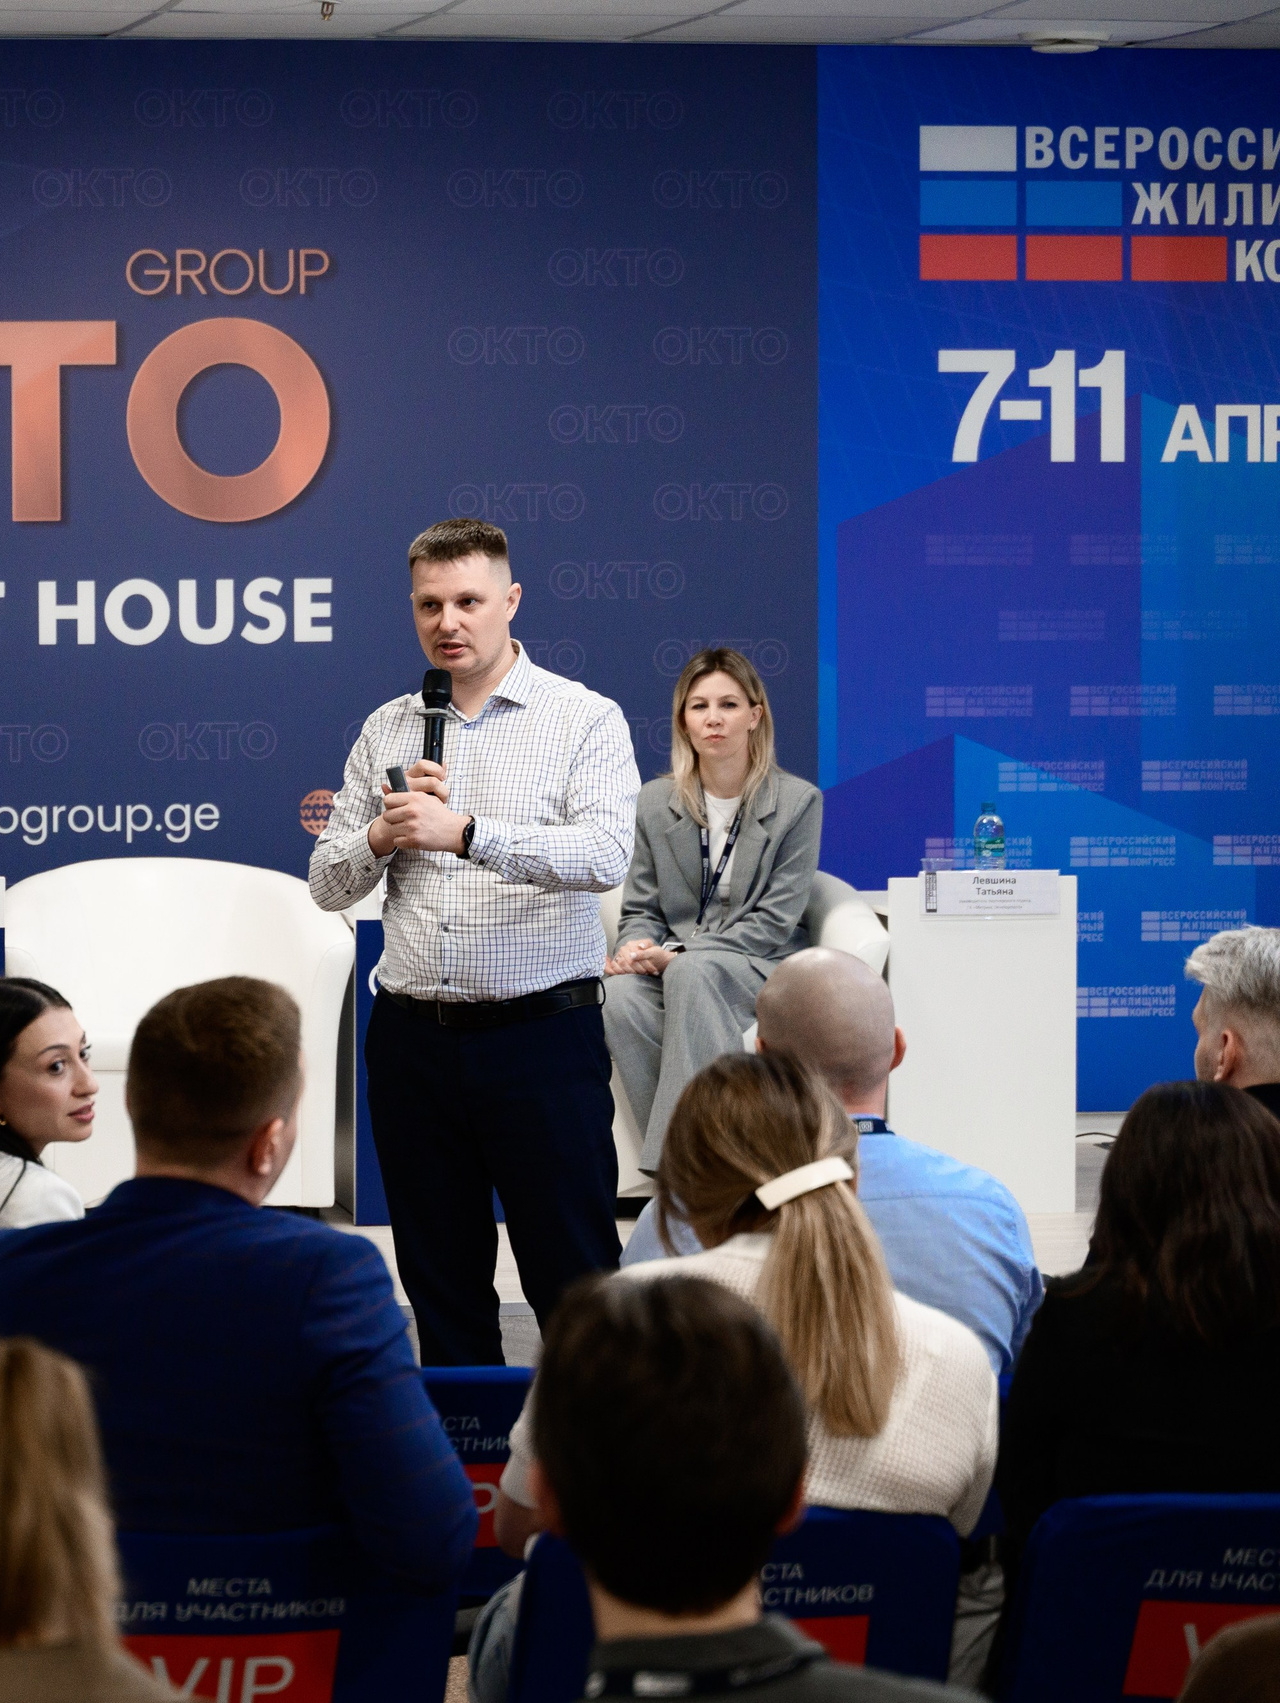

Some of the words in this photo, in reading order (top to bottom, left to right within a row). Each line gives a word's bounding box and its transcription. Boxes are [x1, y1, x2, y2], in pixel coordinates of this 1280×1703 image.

[1025, 125, 1280, 171] ВСЕРОССИ
[125, 248, 329, 297] GROUP
[938, 349, 1125, 463] 7-11
[38, 576, 334, 646] HOUSE
[1089, 835, 1176, 846] ВСЕРОССИЙСКИЙ
[1110, 846, 1176, 857] ЖИЛИЩНЫЙ
[1129, 857, 1176, 867] КОНГРЕСС
[972, 876, 1017, 885] Левшина
[976, 888, 1014, 896] Татьяна
[1160, 909, 1247, 920] ВСЕРОССИЙСКИЙ
[1088, 985, 1176, 996] ВСЕРОССИЙСКИЙ
[1109, 996, 1176, 1007] ЖИЛИЩНЫЙ
[1129, 1007, 1176, 1017] КОНГРЕСС
[1143, 1567, 1205, 1592] ДЛЯ
[186, 1576, 273, 1598] МЕСТА
[175, 1595, 347, 1623] УЧАСТНИКОВ
[149, 1655, 297, 1703] VIP
